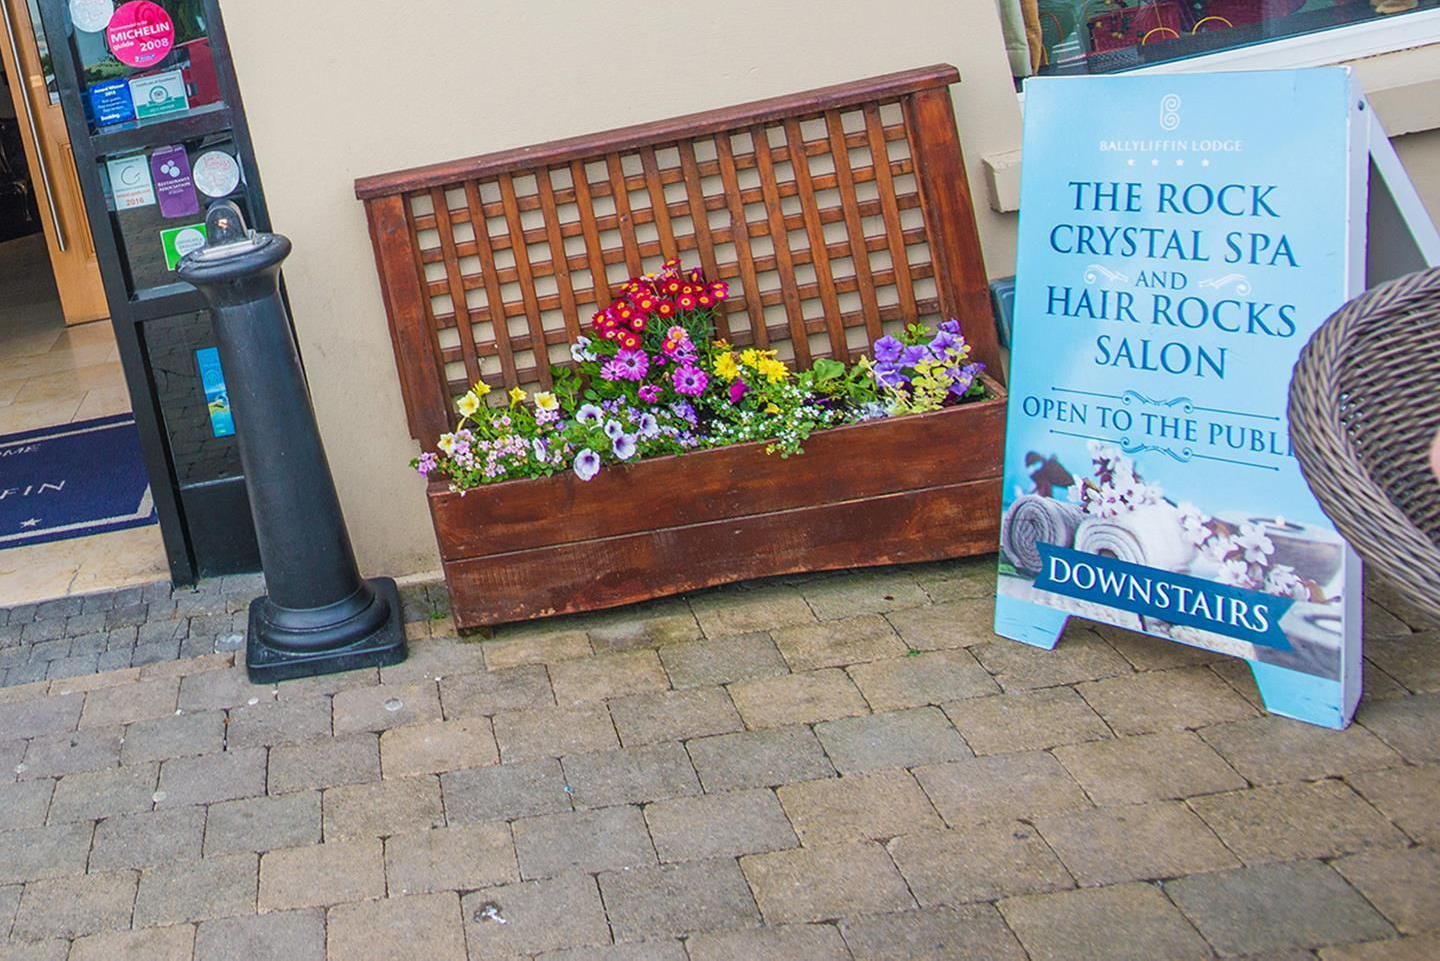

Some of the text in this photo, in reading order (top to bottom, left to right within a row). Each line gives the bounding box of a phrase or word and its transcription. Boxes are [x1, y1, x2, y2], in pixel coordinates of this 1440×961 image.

[110, 21, 170, 44] MICHELIN
[113, 38, 169, 53] guide 2008
[1099, 139, 1243, 153] BALLYLIFFIN LODGE
[1068, 181, 1280, 218] THE ROCK
[1049, 223, 1299, 267] CRYSTAL SPA
[1135, 270, 1188, 290] AND
[1045, 286, 1297, 337] HAIR ROCKS
[1094, 336, 1227, 380] SALON
[1022, 396, 1087, 424] OPEN
[1096, 406, 1133, 432] TO
[1142, 414, 1198, 444] THE
[1047, 555, 1270, 633] DOWNSTAIRS
